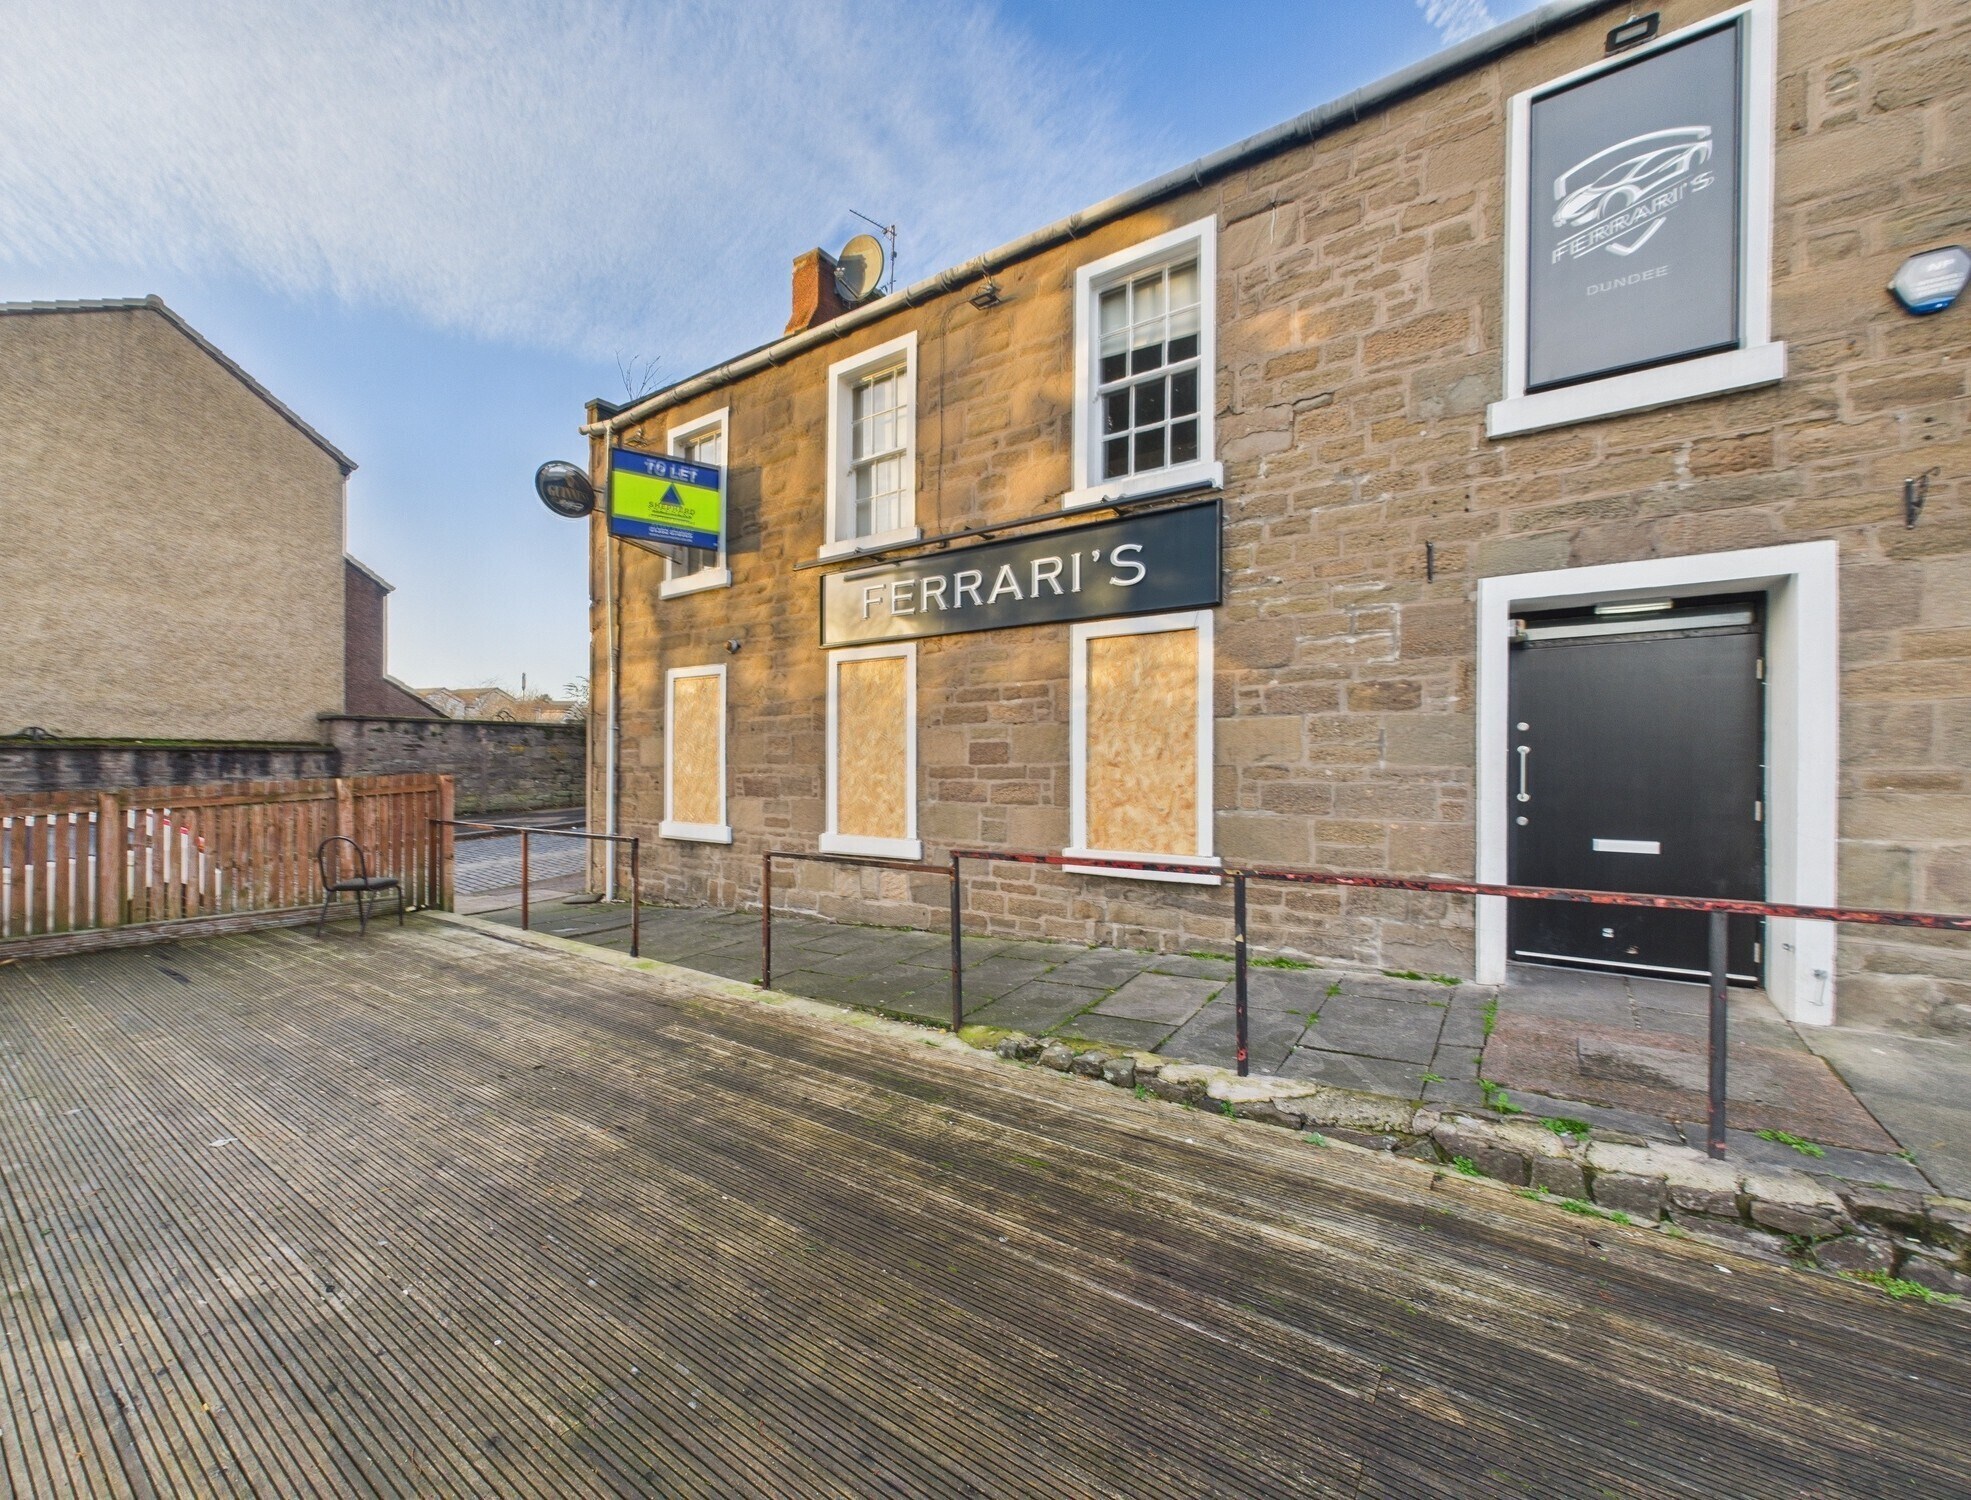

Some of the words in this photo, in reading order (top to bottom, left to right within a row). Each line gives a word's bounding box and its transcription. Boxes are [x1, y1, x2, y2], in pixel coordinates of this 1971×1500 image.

[1552, 170, 1715, 265] FERRARI'S
[1586, 265, 1669, 296] DUNDEE
[644, 458, 667, 477] TO
[669, 464, 698, 483] LET
[861, 543, 1147, 620] FERRARI'S
